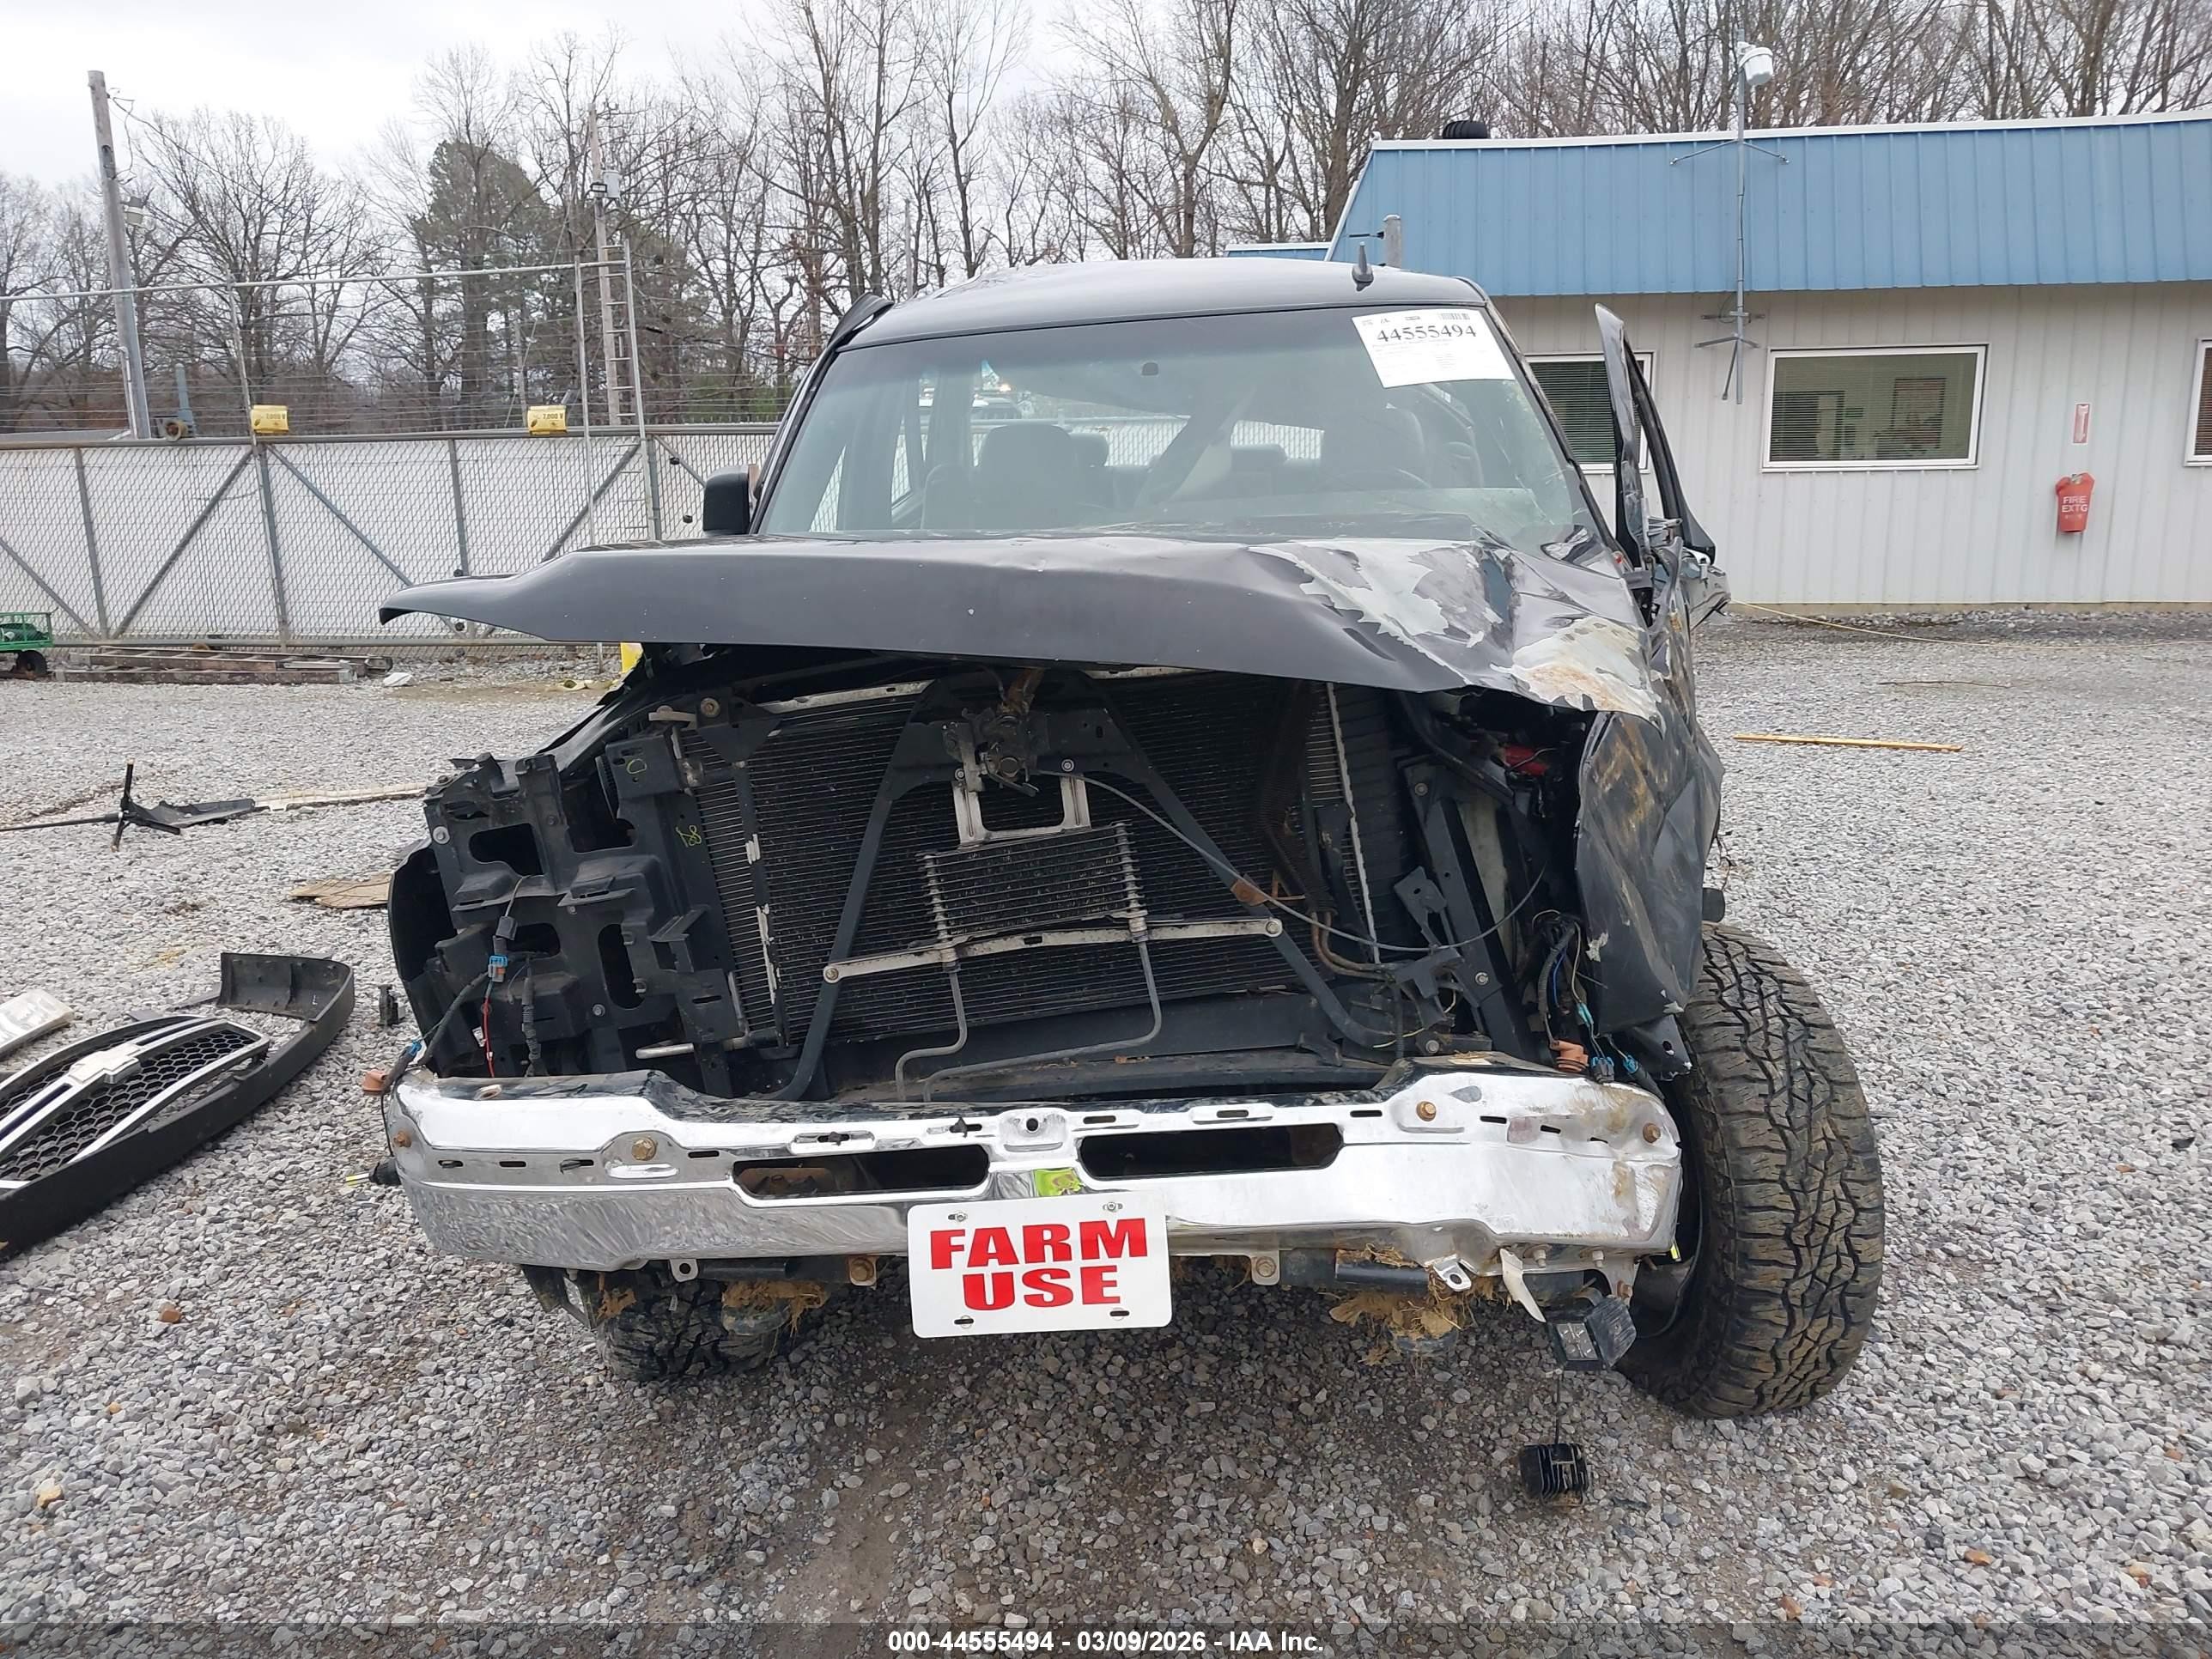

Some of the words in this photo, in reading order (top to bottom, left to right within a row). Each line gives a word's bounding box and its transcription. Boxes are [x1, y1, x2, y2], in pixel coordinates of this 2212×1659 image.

[1376, 324, 1477, 343] 44555494
[2062, 504, 2088, 513] EXTG
[2063, 495, 2087, 504] FIRE
[930, 1218, 1148, 1270] FARM
[963, 1265, 1121, 1311] USE
